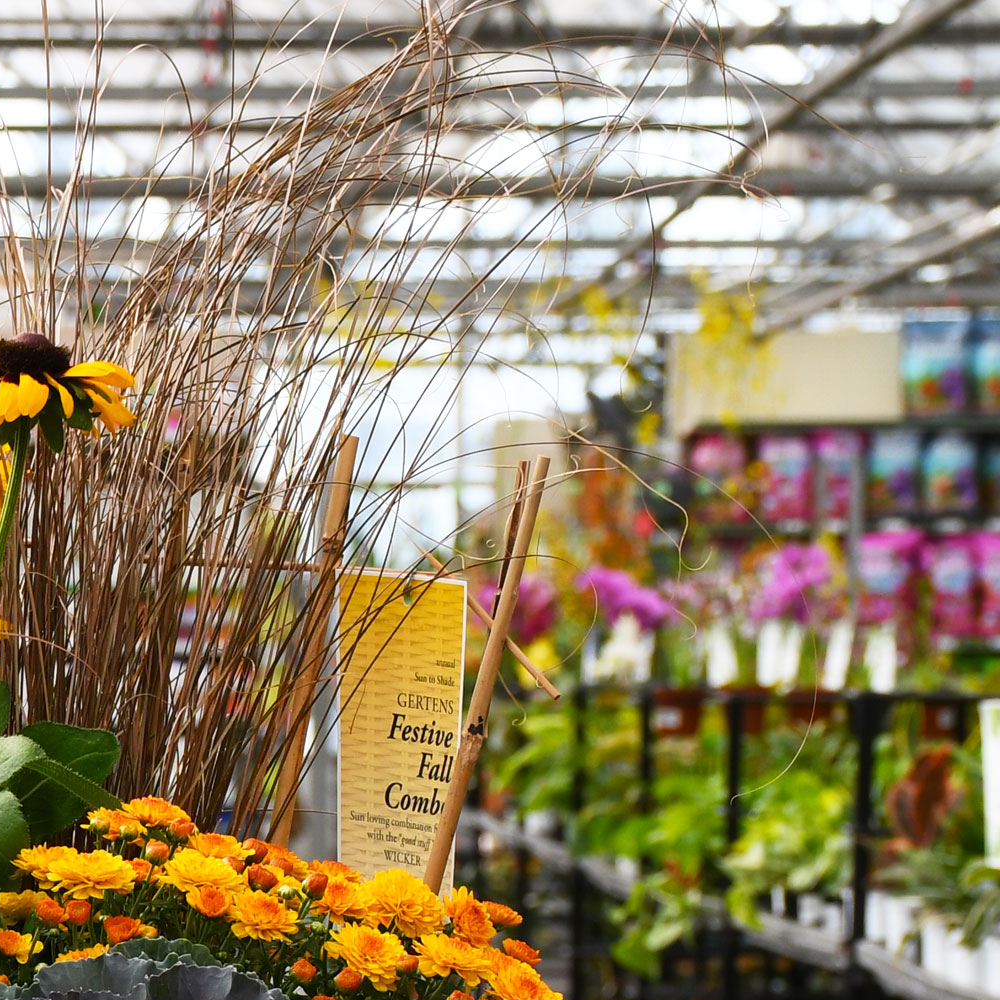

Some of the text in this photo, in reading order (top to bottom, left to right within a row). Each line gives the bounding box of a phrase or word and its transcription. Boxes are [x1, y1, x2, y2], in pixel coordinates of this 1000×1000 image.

[436, 659, 456, 668] annual
[414, 672, 455, 687] Sun to Shade
[397, 692, 454, 715] GERTENS
[387, 712, 454, 748] Festive
[416, 751, 454, 783] Fall
[350, 810, 365, 821] Sun
[366, 811, 390, 829] loving
[391, 817, 433, 833] combination
[367, 829, 384, 841] with
[386, 831, 398, 842] the
[384, 849, 421, 866] WICKER
